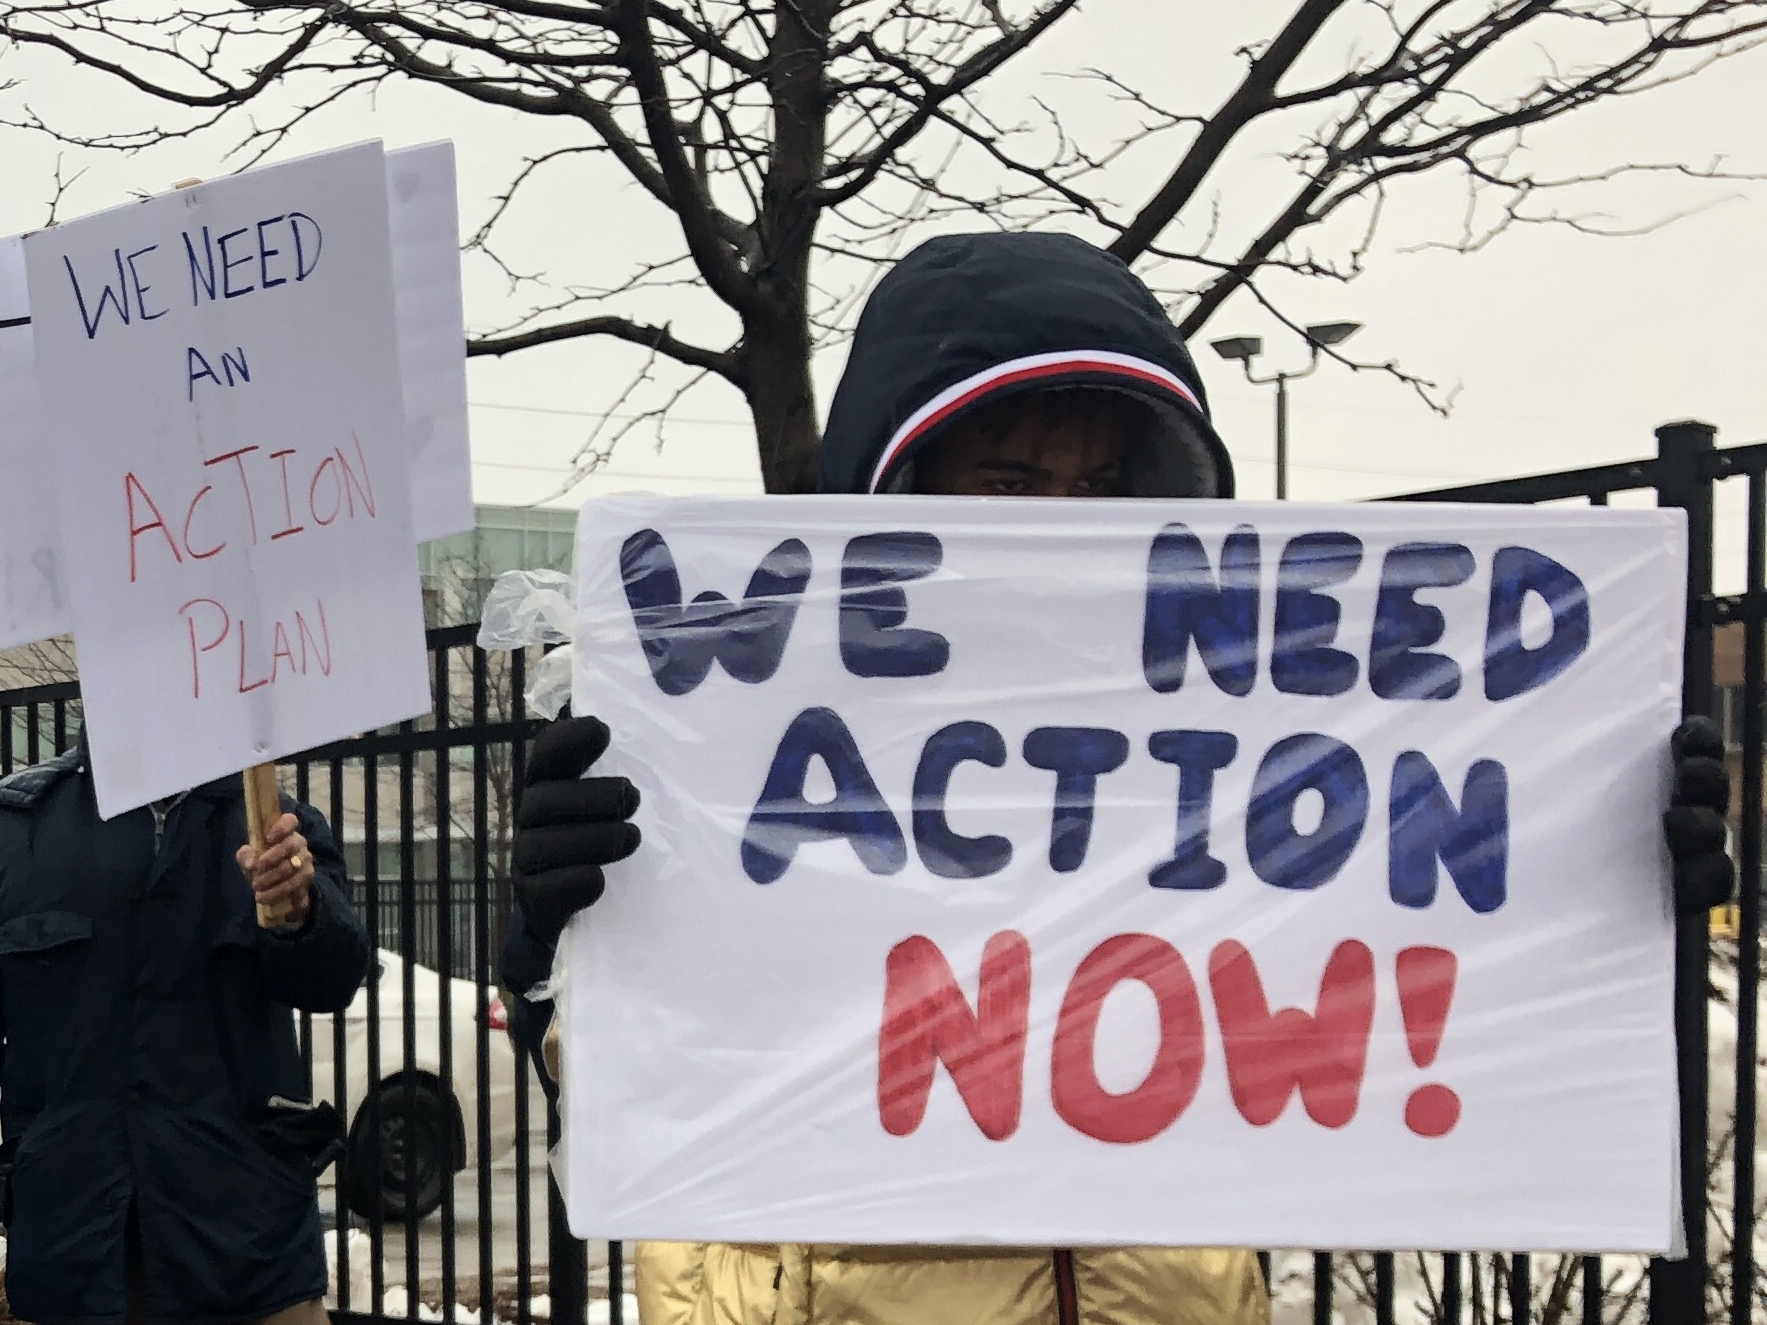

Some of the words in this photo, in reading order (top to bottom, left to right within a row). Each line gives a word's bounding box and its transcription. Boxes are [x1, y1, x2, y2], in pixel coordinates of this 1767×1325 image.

[63, 245, 170, 340] WE
[181, 212, 323, 306] NEED
[186, 346, 251, 402] AN
[125, 429, 376, 583] ACTION
[177, 599, 332, 699] PLAN
[619, 527, 950, 697] WE
[1143, 521, 1592, 702] NEED
[740, 705, 1509, 914] ACTION
[877, 928, 1464, 1144] NOW!
